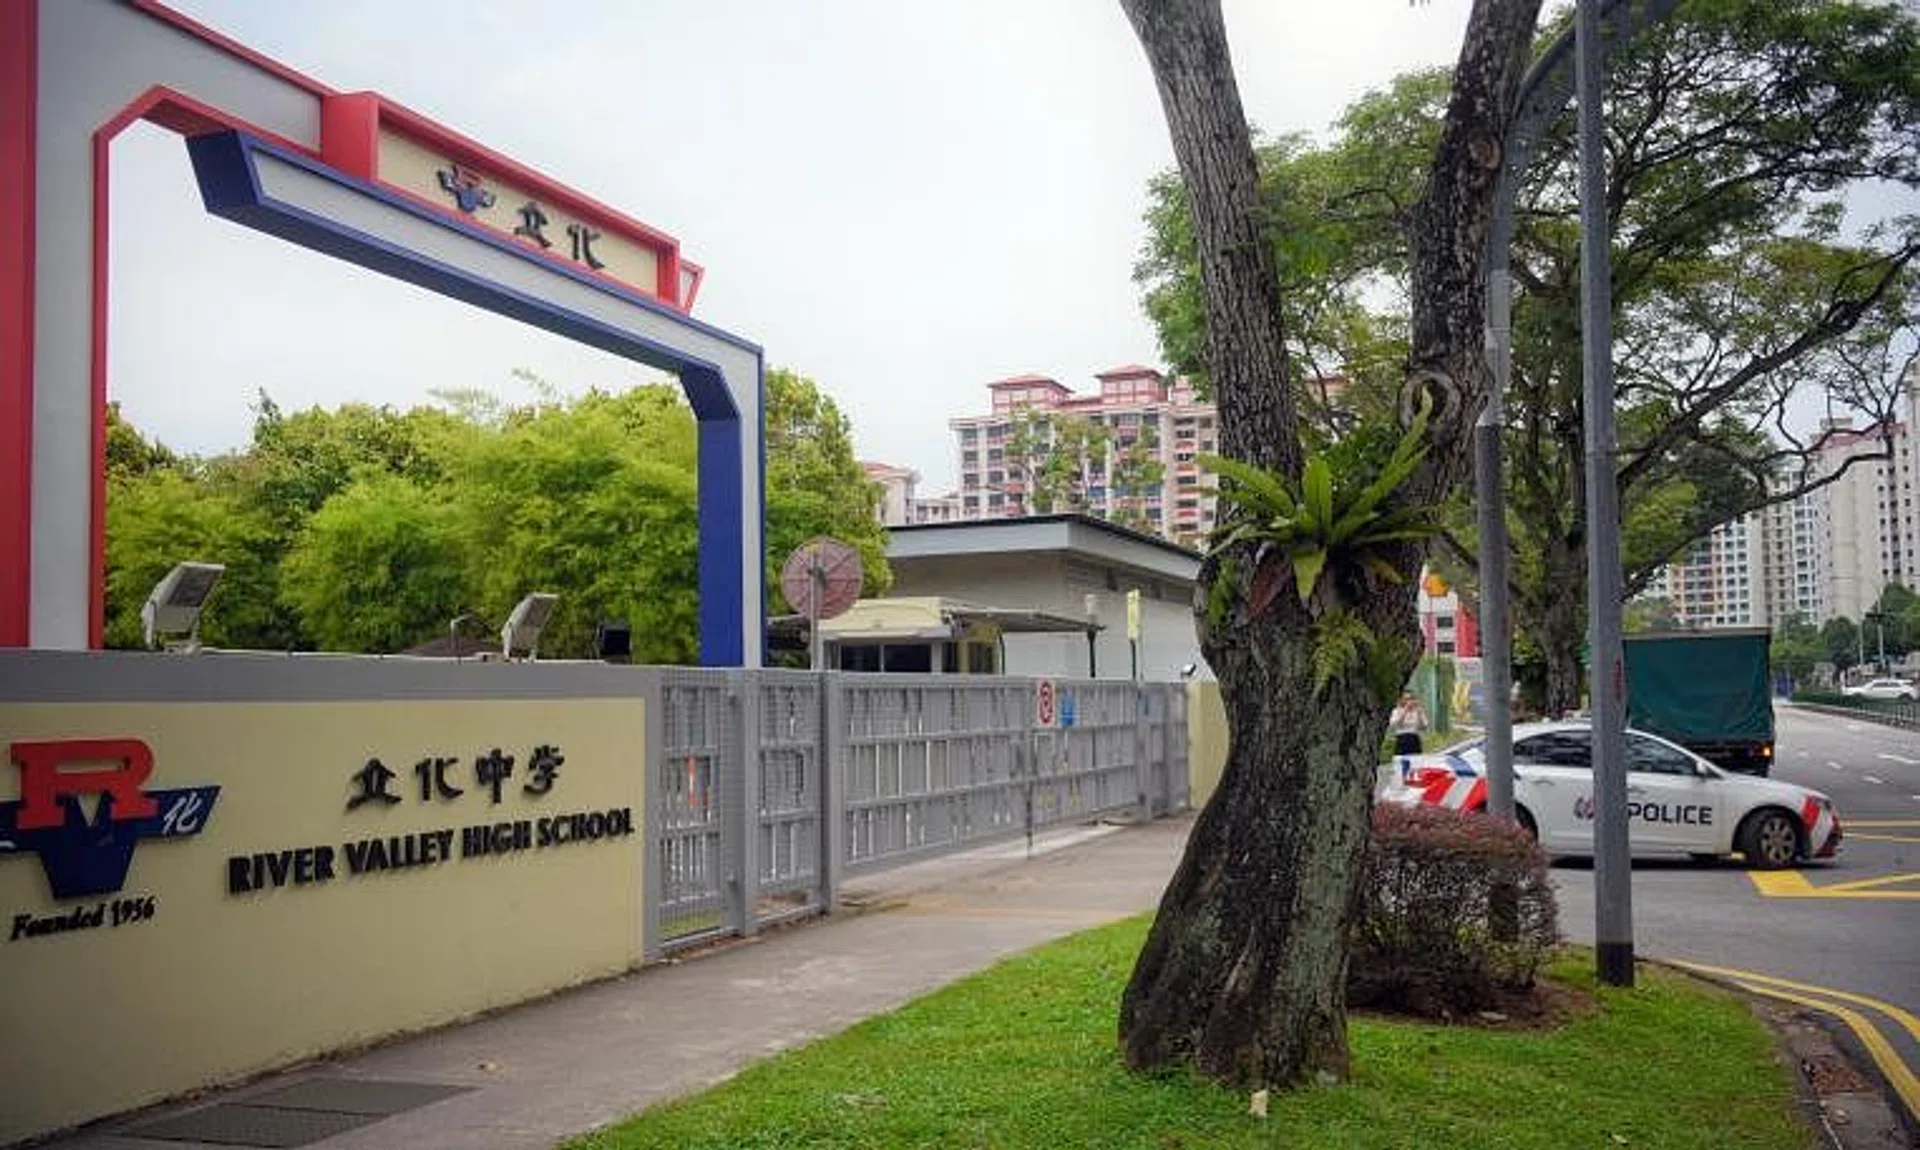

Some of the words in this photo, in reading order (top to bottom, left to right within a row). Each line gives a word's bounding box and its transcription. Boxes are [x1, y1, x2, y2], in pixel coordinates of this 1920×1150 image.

[514, 202, 605, 269] 立化
[345, 745, 564, 811] 立化中学
[1627, 802, 1713, 825] POLICE
[228, 846, 335, 894] RIVER
[343, 829, 454, 875] VALLEY
[462, 820, 532, 857] HIGH
[536, 807, 635, 847] SCHOOL
[9, 902, 104, 942] Founded
[111, 896, 156, 926] 1956
